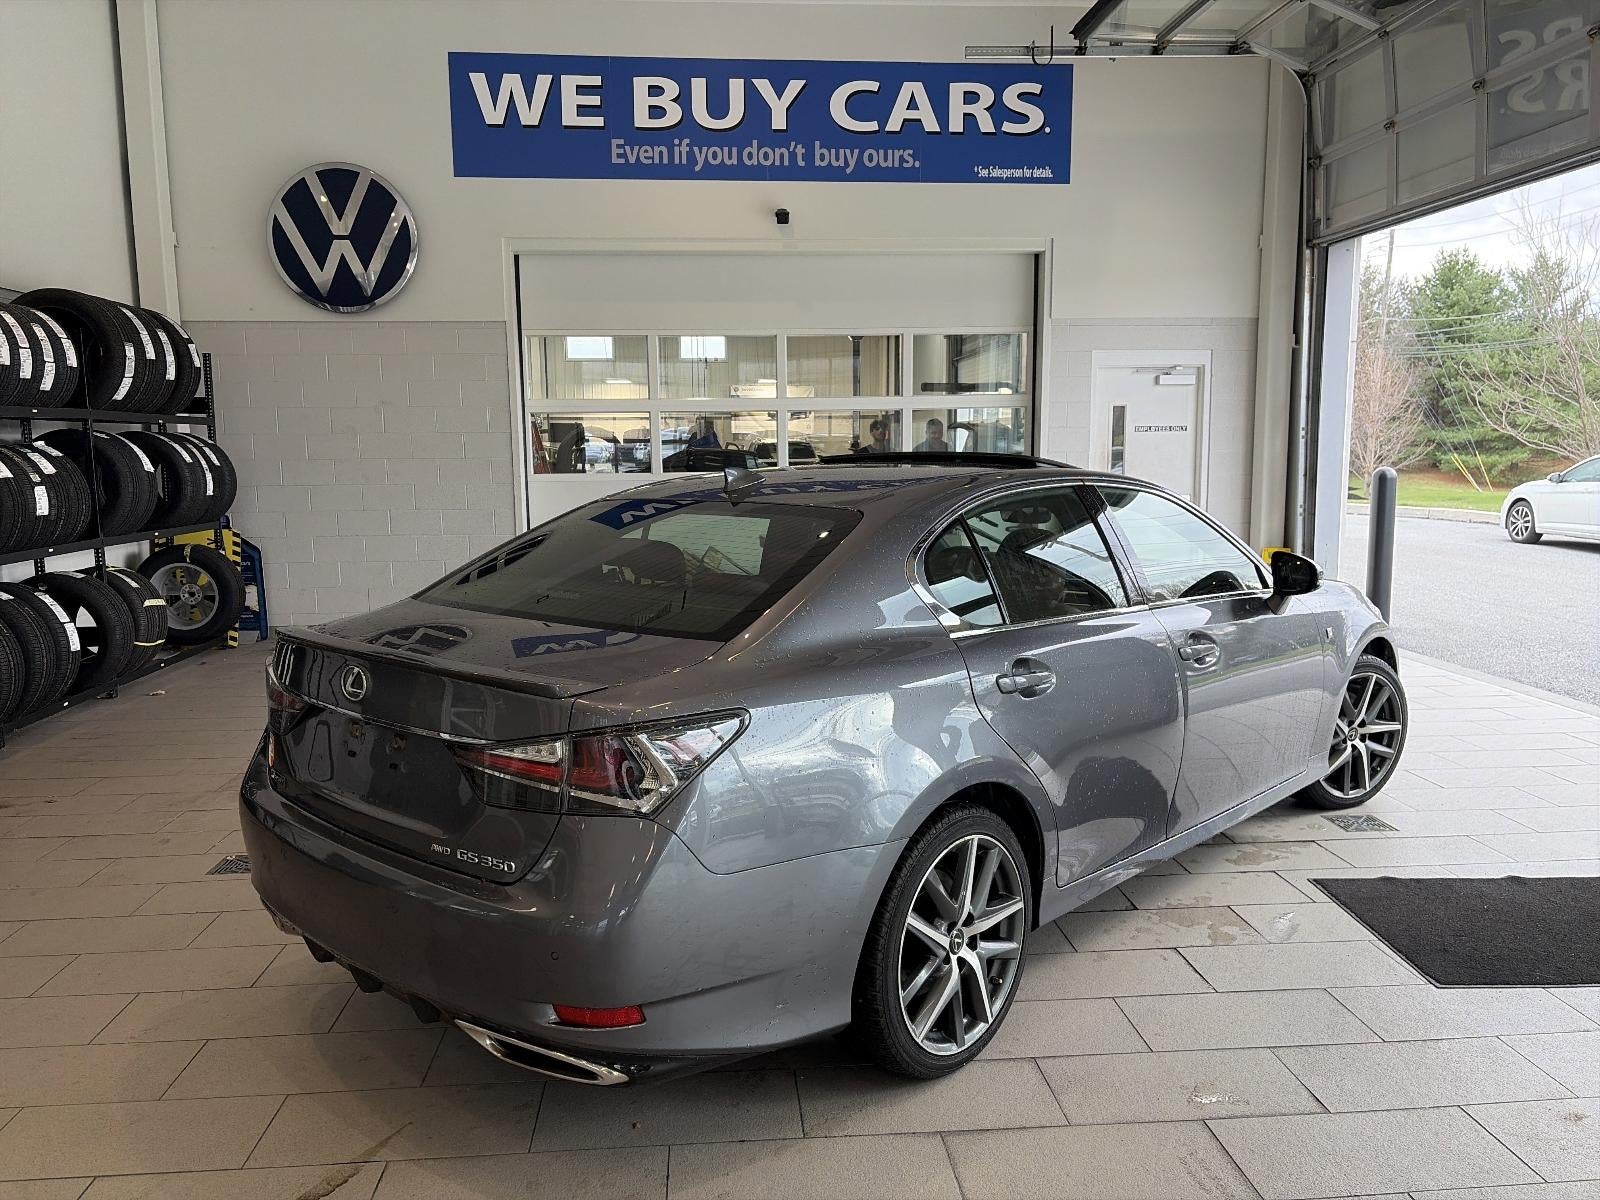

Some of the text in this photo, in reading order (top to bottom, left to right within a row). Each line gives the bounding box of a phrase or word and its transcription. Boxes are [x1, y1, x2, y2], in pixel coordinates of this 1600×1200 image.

[468, 72, 1051, 134] WE BUY CARS.
[611, 138, 920, 174] Even if you don't buy ours.
[978, 166, 988, 177] See
[990, 165, 1022, 180] Salesperson
[1024, 166, 1032, 178] for
[430, 844, 516, 873] AWD GS 350
